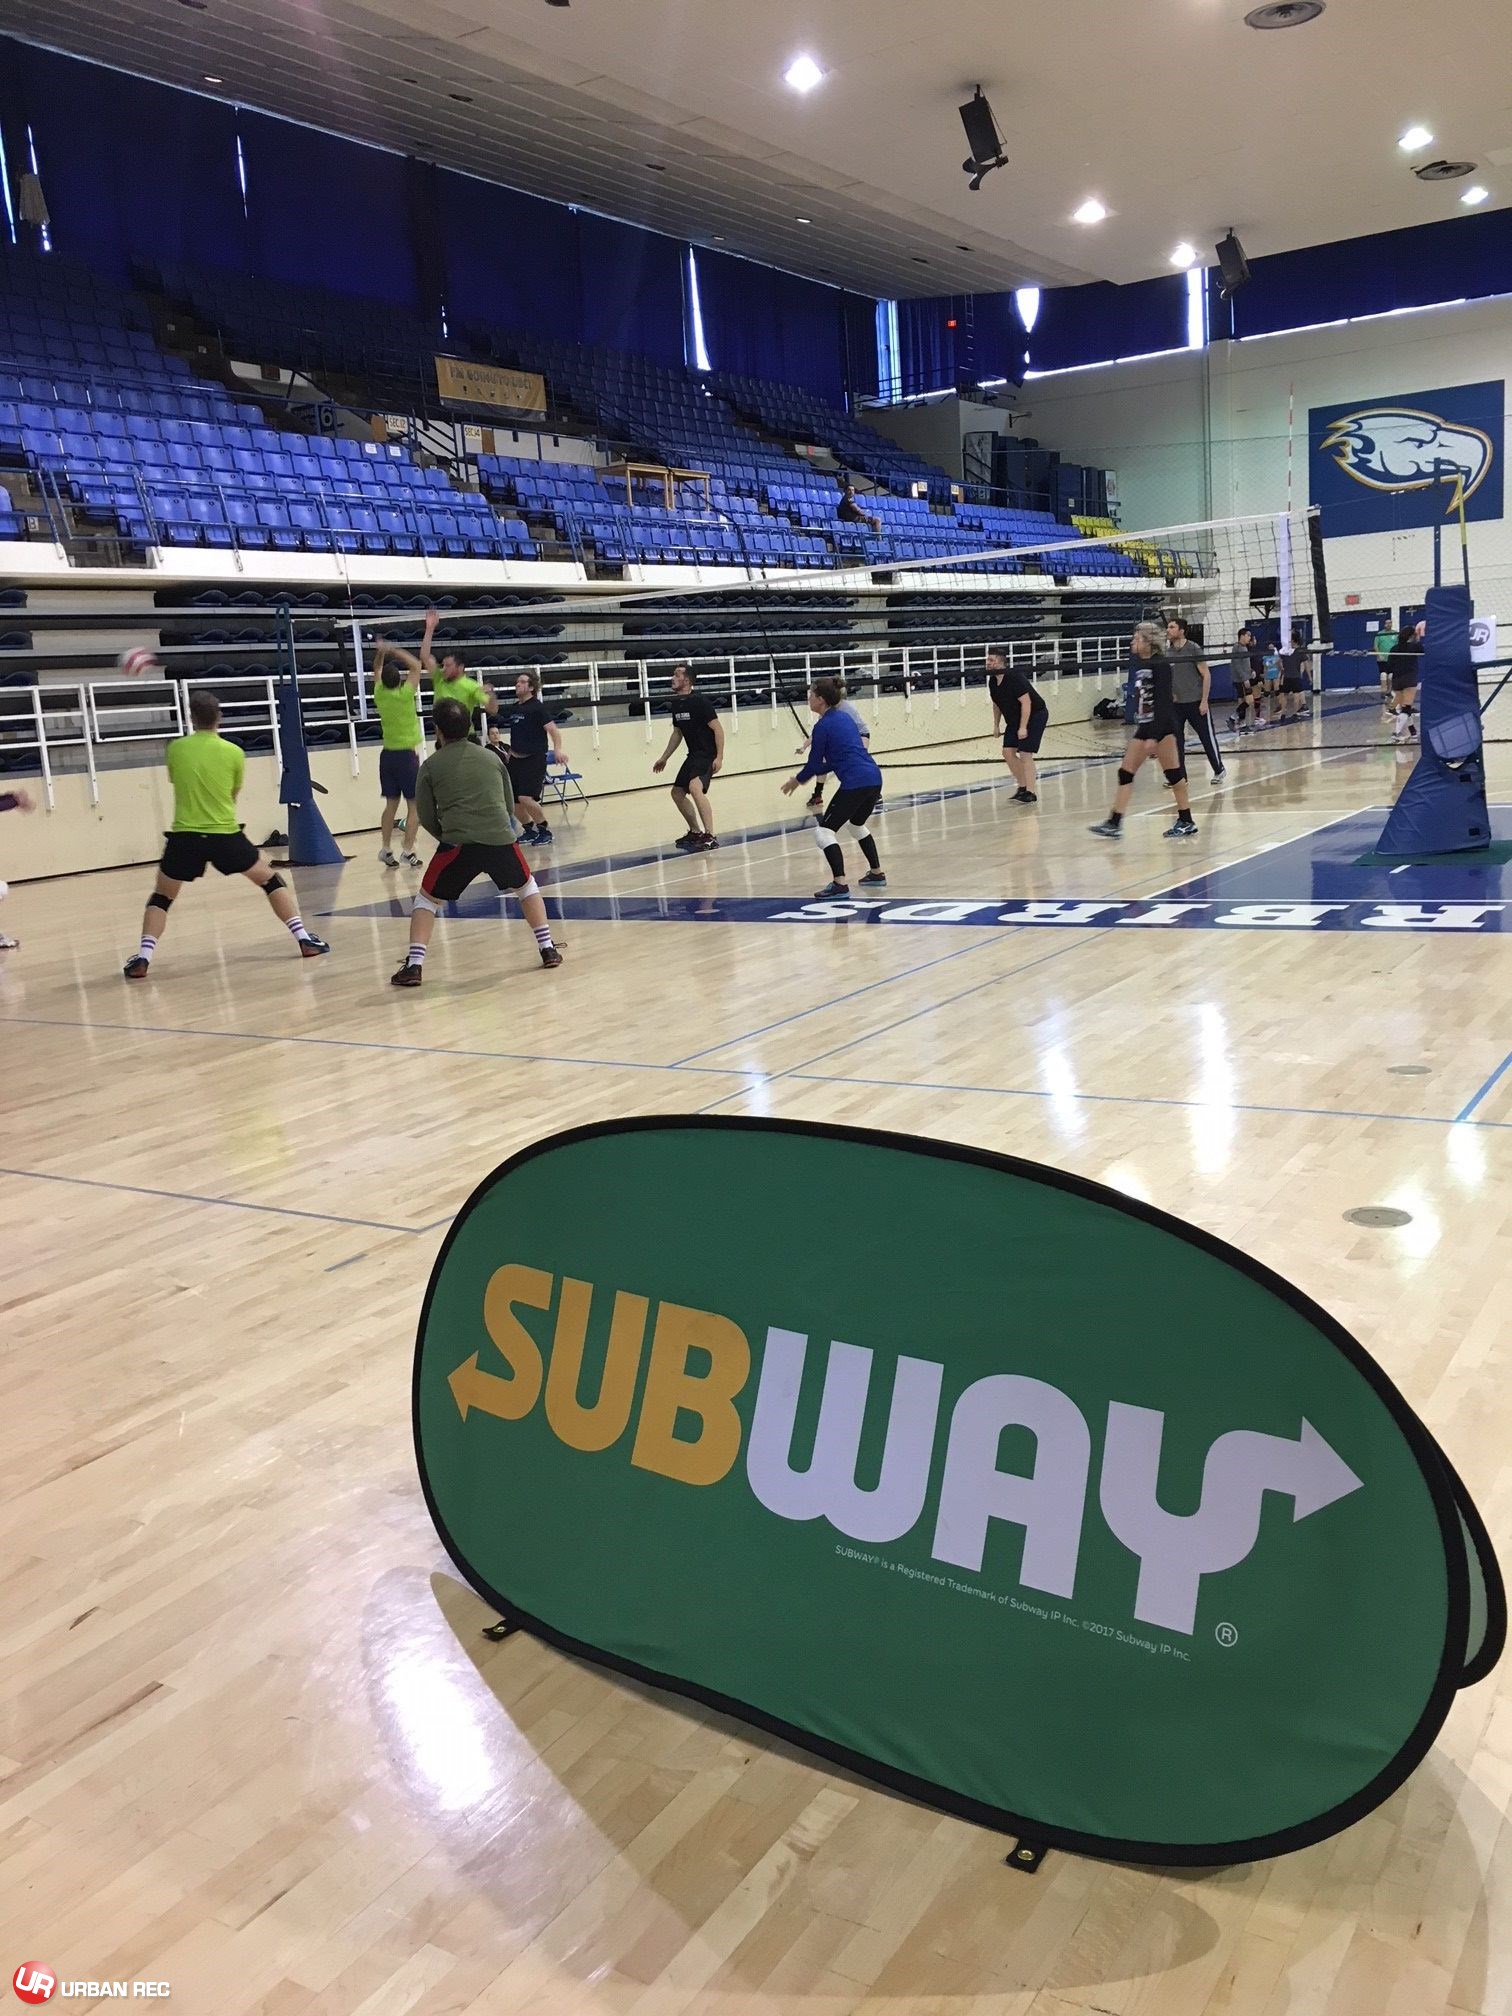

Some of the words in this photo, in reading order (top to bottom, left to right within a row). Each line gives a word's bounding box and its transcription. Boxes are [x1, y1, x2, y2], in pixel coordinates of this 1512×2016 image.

[447, 1263, 1365, 1636] SUBWAY
[881, 1557, 888, 1569] is
[897, 1564, 946, 1586] Registered
[947, 1578, 996, 1601] Trademark
[998, 1595, 1009, 1605] of
[1009, 1598, 1049, 1620] Subway
[1050, 1611, 1062, 1621] IP
[1063, 1614, 1080, 1629] Inc.
[1116, 1630, 1157, 1654] Subway
[1159, 1643, 1172, 1654] IP
[1173, 1647, 1192, 1662] Inc.
